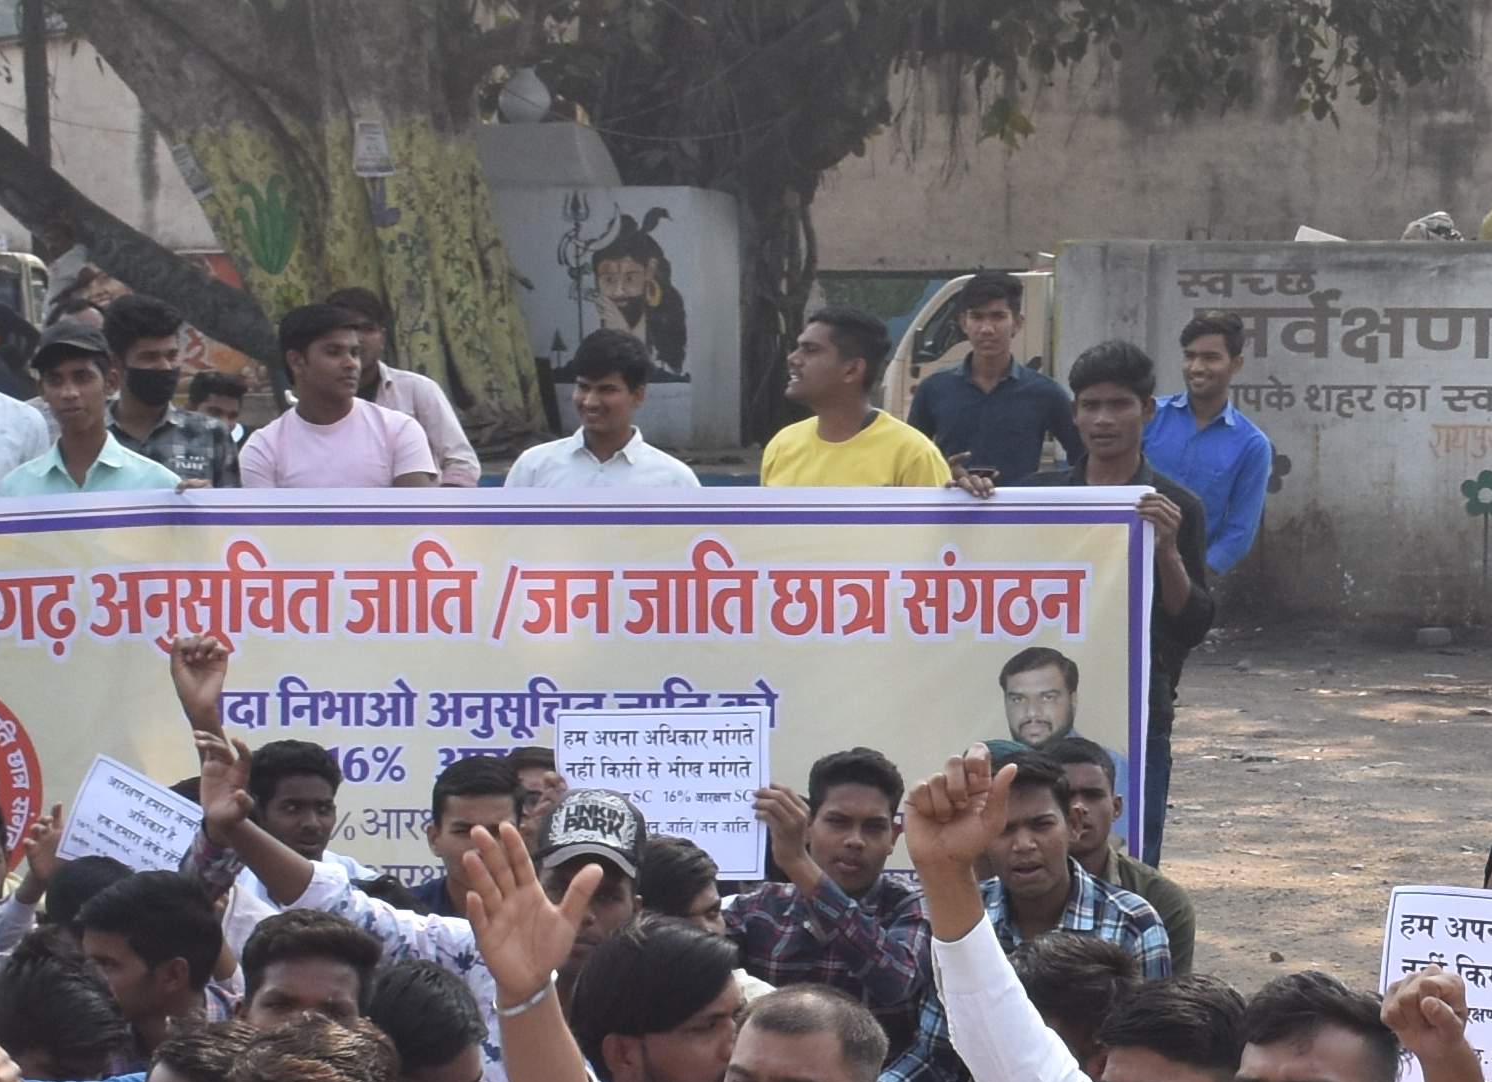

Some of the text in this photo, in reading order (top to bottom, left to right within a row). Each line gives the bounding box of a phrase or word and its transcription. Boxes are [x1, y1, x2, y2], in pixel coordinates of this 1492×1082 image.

[1177, 269, 1320, 297] स्वच्छ
[1304, 384, 1378, 418] शहर
[1383, 383, 1430, 412] का
[91, 540, 335, 655] अनुसूचित
[344, 540, 477, 636] जाति
[623, 540, 760, 637] जाति
[768, 570, 890, 637] छात्र
[901, 550, 1087, 637] संगठन
[276, 675, 417, 728] निभाओ
[564, 723, 754, 749] हम अपना अधिकार मांगते
[6, 749, 31, 790] छात्र
[565, 755, 752, 779] नहीं किसी से भीख मांगते
[563, 815, 623, 835] PARK
[565, 804, 626, 829] LINKIN
[1400, 914, 1439, 941] हम
